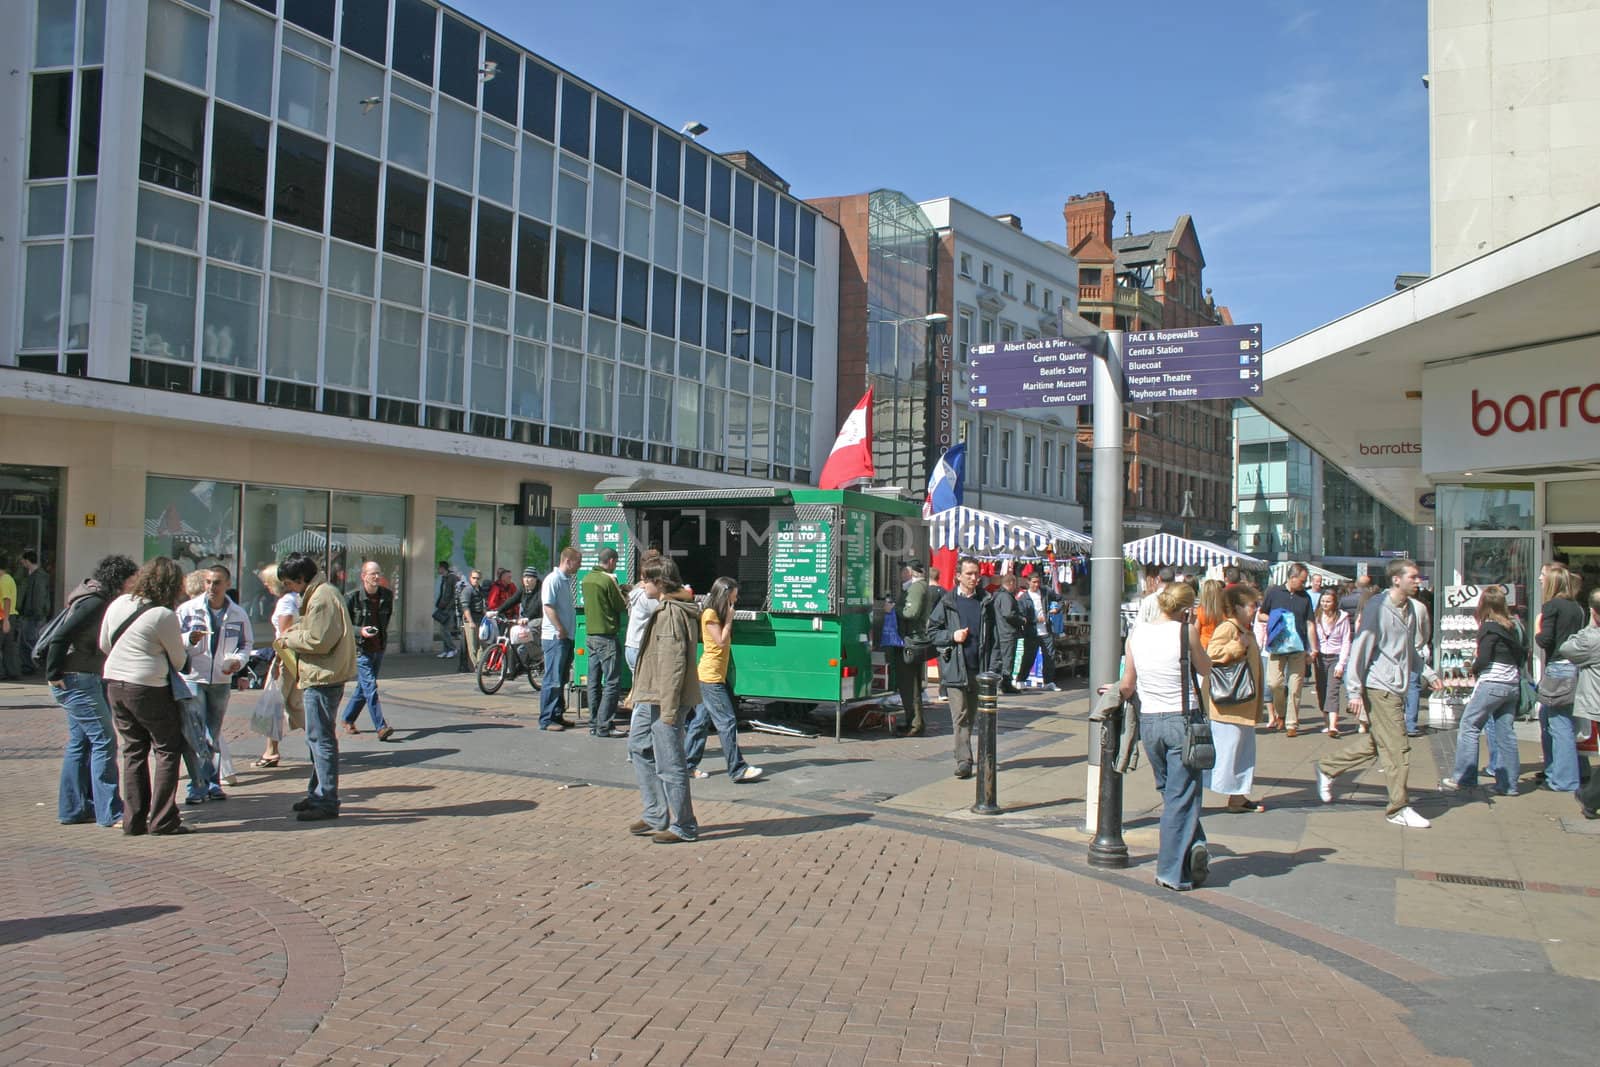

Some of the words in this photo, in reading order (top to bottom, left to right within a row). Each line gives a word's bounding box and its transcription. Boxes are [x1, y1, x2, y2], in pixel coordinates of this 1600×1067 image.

[1128, 333, 1147, 342] FACT
[1149, 332, 1155, 341] &
[1157, 330, 1199, 342] Ropewalks
[1003, 342, 1025, 352] Albert
[1026, 340, 1044, 350] Dock
[1045, 340, 1051, 349] &
[1053, 339, 1066, 348] Pier
[1128, 347, 1154, 357] Central
[1157, 345, 1183, 354] Station
[1033, 354, 1057, 363] Cavern
[1059, 352, 1086, 362] Quarter
[1040, 367, 1066, 376] Beatles
[1068, 366, 1087, 376] Story
[1128, 361, 1161, 370] Bluecoat
[1023, 381, 1055, 391] Maritime
[1057, 379, 1087, 389] Museum
[1128, 375, 1161, 387] Neptune
[1163, 373, 1192, 383] Theatre
[1042, 394, 1065, 403] Crown
[1067, 393, 1087, 402] Court
[1128, 389, 1167, 401] Playhouse
[1168, 387, 1197, 397] Theatre
[528, 494, 548, 517] GAP
[1448, 584, 1479, 608] £10
[782, 600, 798, 609] TEA
[804, 601, 818, 610] 40p
